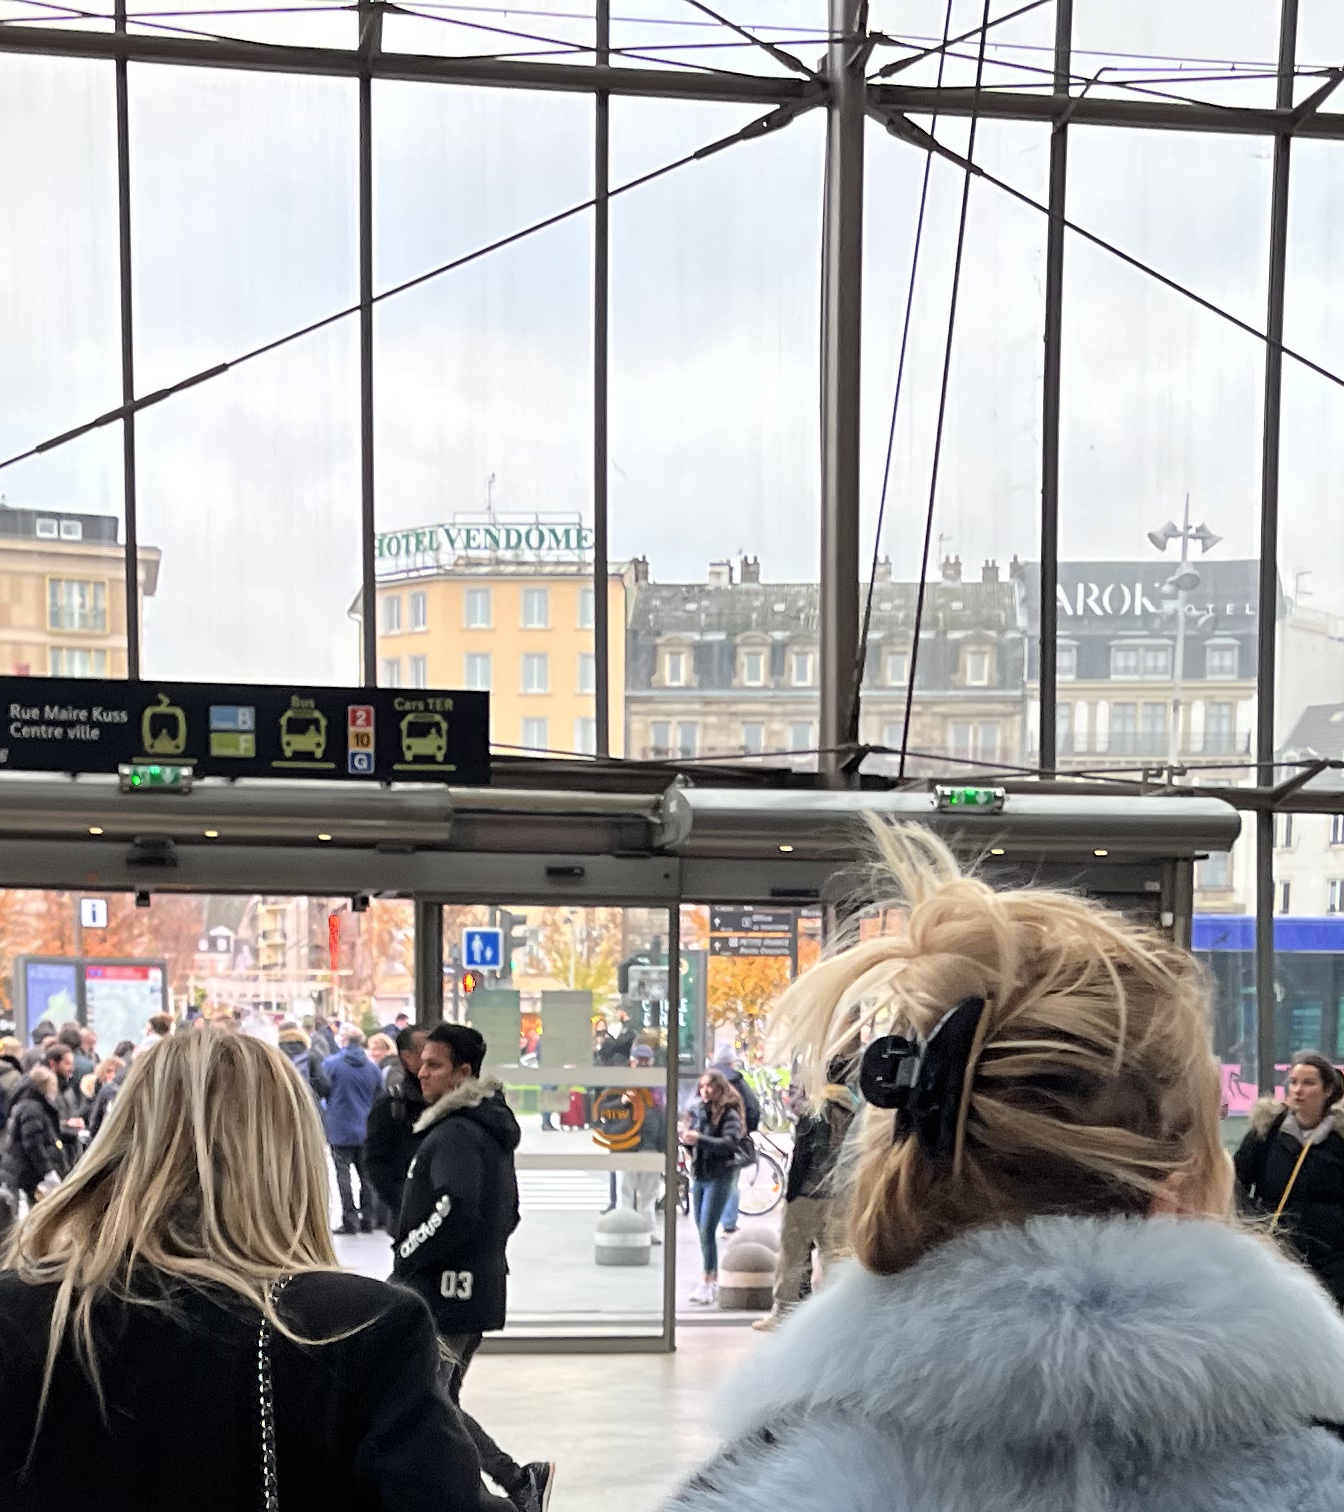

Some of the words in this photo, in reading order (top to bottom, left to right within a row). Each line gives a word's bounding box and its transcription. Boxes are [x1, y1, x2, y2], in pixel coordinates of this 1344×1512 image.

[440, 526, 594, 551] VENDOME
[1164, 603, 1256, 616] OTEL
[9, 703, 41, 720] Rue
[44, 705, 89, 722] Maire
[92, 706, 128, 724] Kuss
[394, 697, 424, 712] Cars
[427, 698, 454, 712] TER
[356, 709, 367, 726] 2
[9, 722, 64, 740] Centre
[67, 725, 101, 741] ville
[353, 732, 371, 748] 10
[440, 1269, 475, 1301] 03
